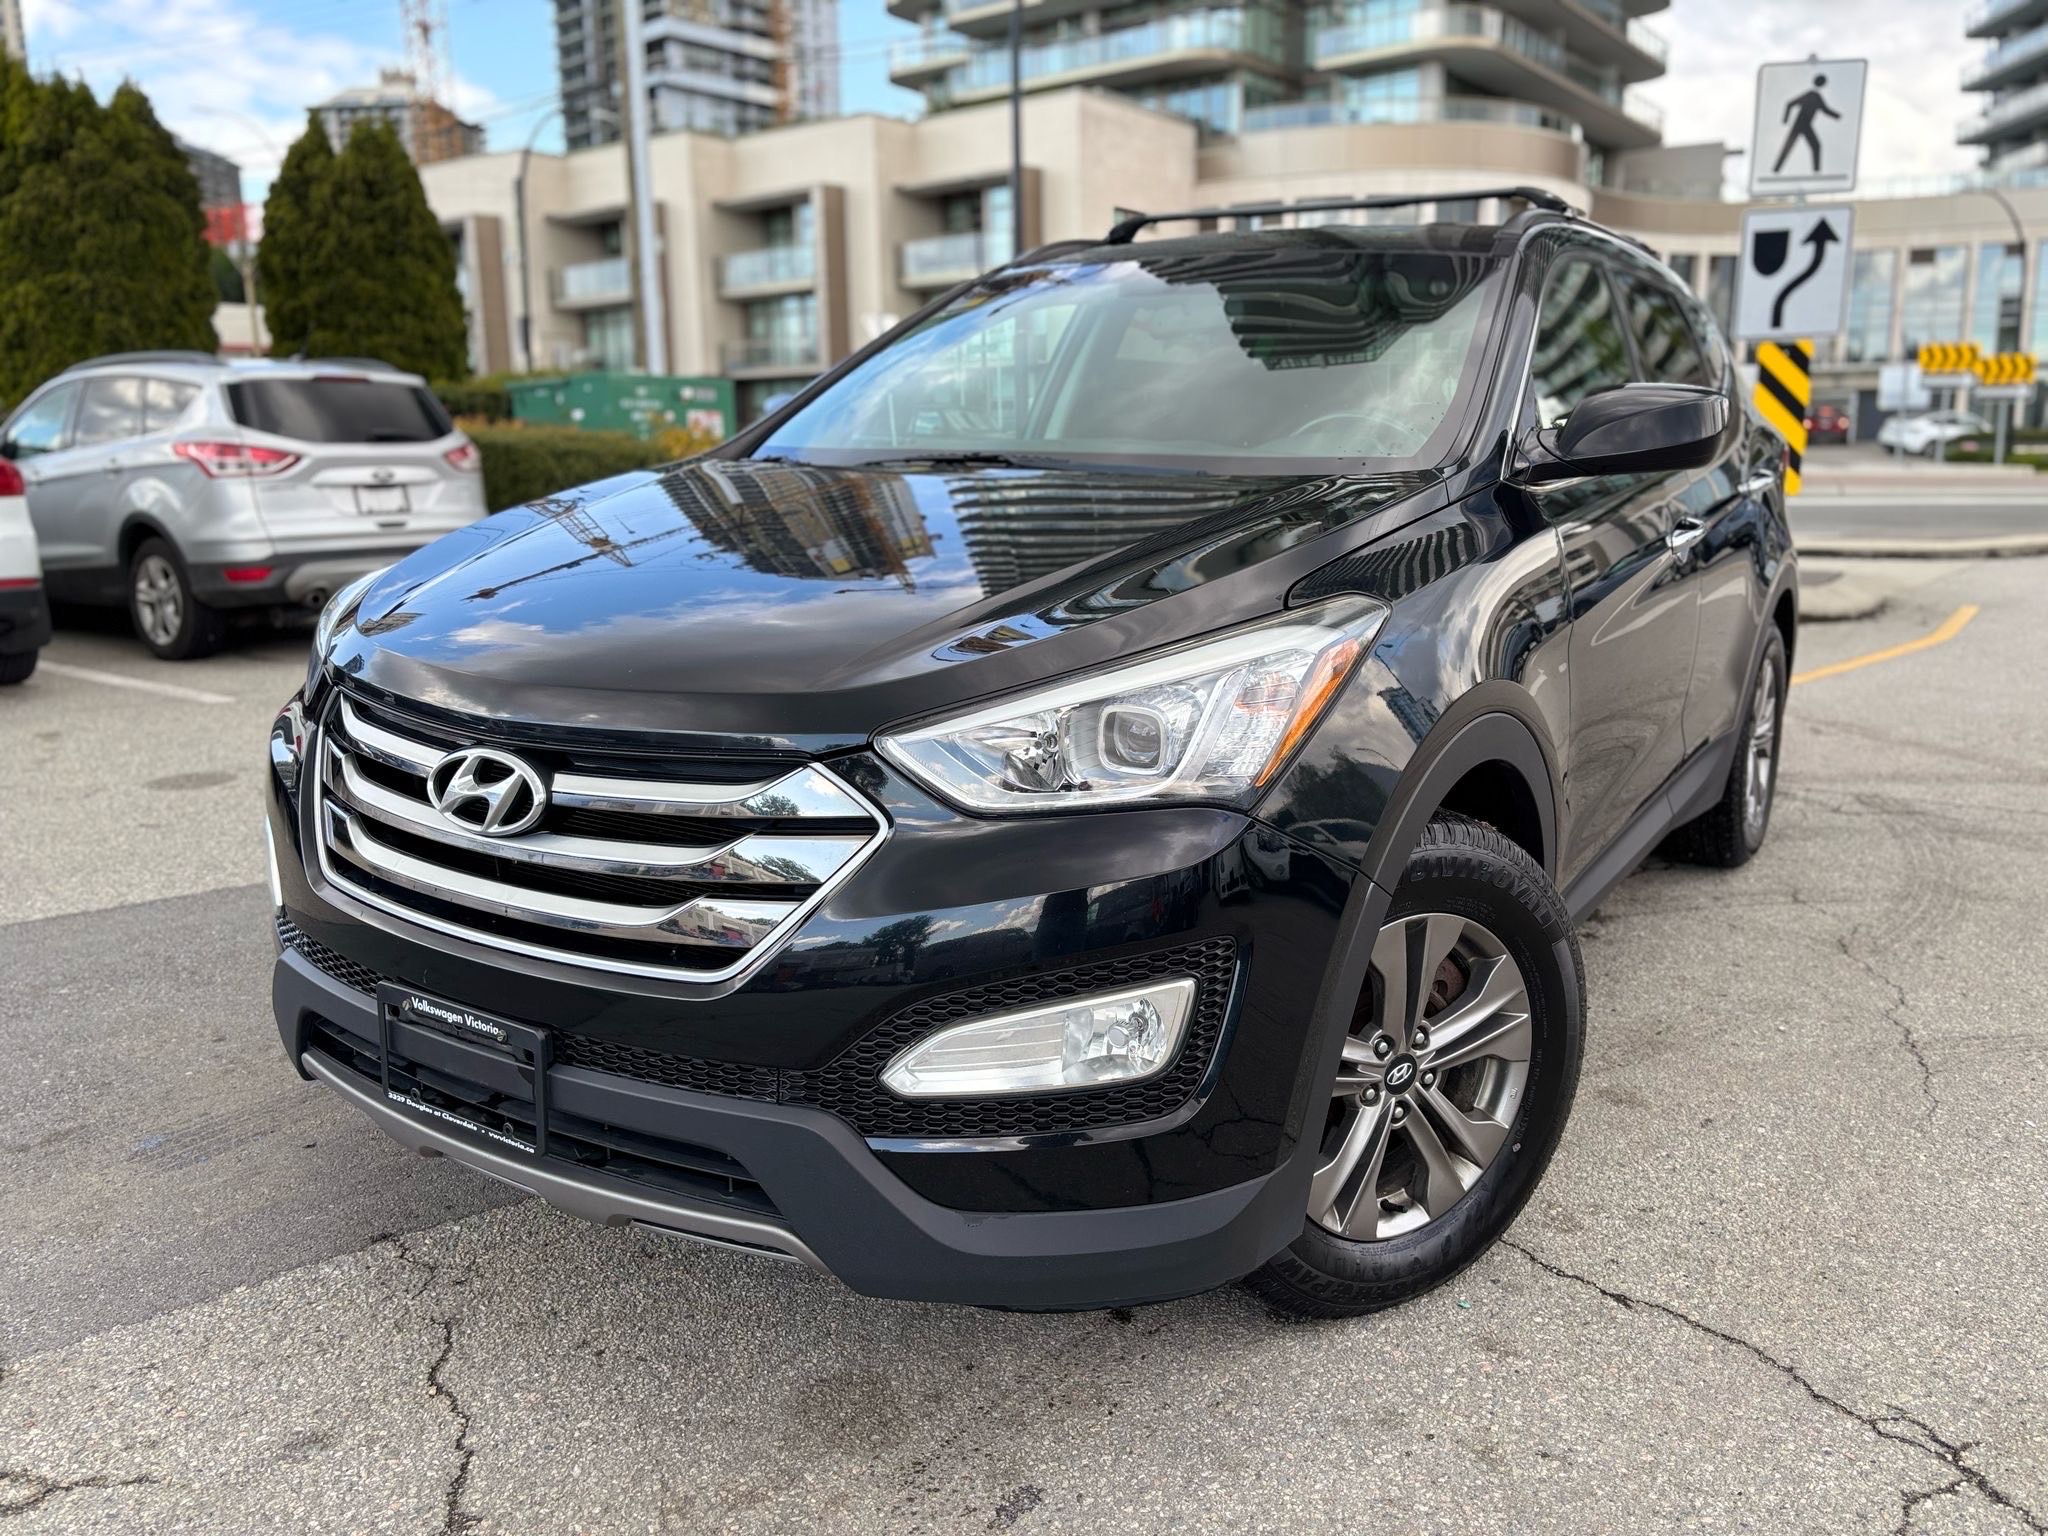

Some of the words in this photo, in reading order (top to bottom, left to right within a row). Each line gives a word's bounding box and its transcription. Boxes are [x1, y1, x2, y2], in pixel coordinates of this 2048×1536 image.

[411, 996, 463, 1024] Volkswagen
[464, 1013, 499, 1035] Victoria
[406, 1098, 433, 1114] Douglas
[442, 1112, 477, 1131] Cloverdale
[488, 1131, 534, 1154] vwvictoria.ca
